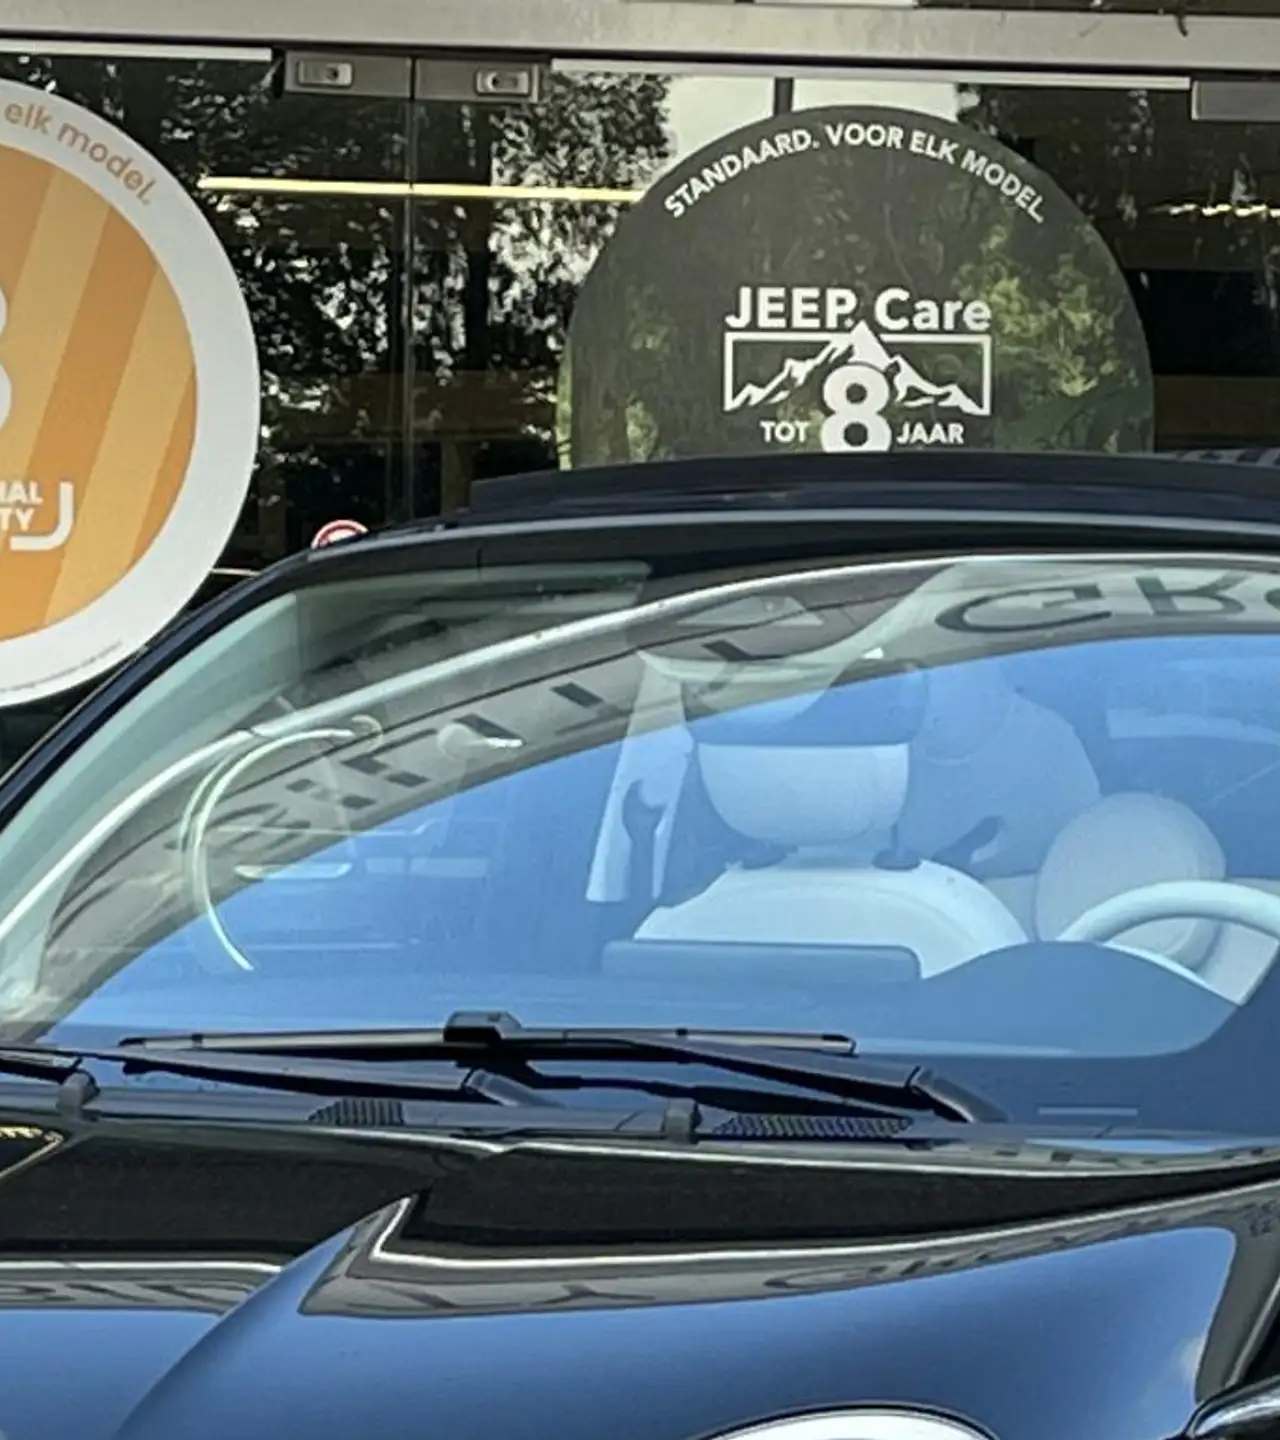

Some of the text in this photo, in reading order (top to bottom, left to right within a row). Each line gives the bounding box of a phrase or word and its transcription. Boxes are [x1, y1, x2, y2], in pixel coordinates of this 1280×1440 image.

[4, 98, 51, 135] elk
[56, 121, 158, 206] model.
[664, 123, 1045, 223] STANDAARD. VOOR ELK MODEL
[874, 287, 992, 332] Care
[760, 363, 965, 453] TOT 8 JAAR
